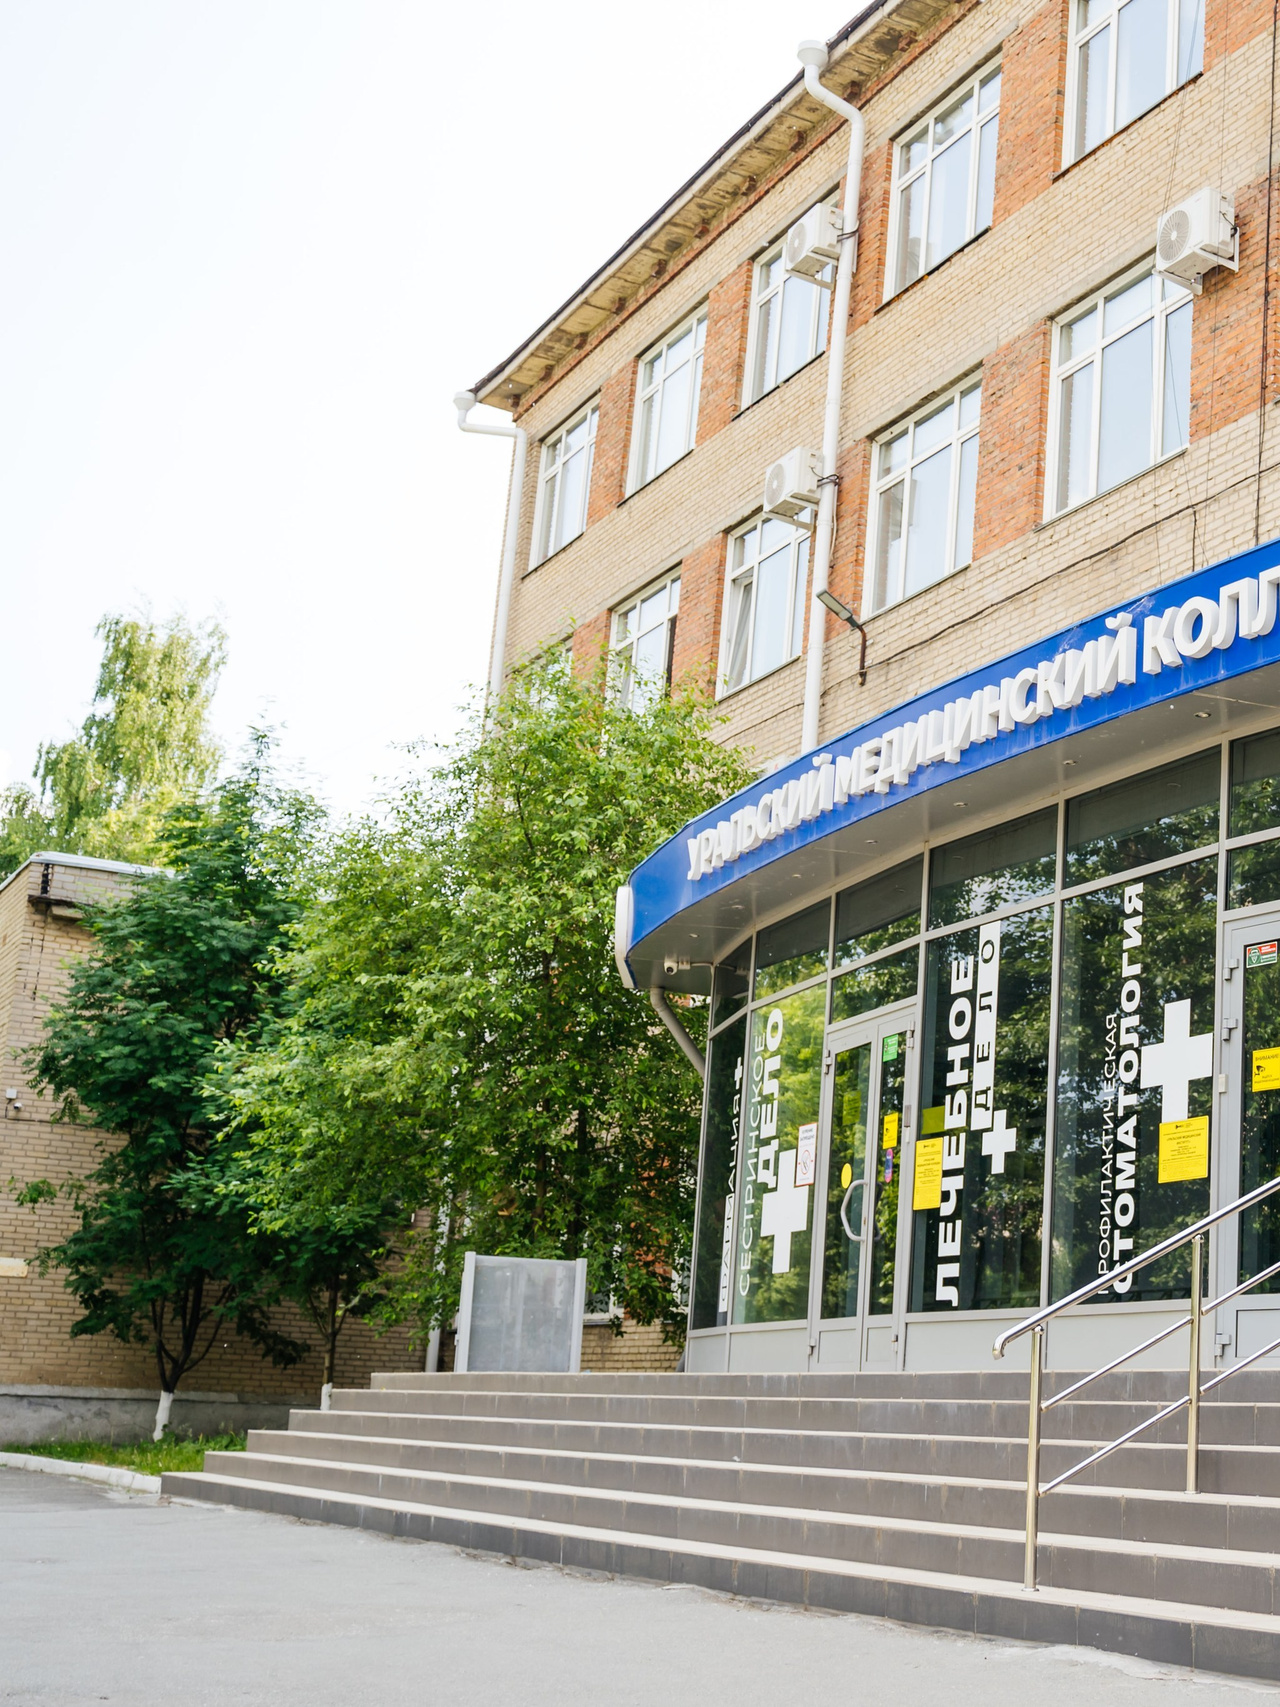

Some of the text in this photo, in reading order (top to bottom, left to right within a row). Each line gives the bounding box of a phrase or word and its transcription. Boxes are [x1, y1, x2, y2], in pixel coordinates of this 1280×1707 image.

[687, 755, 834, 881] УРАЛЬСКИЙ
[834, 616, 1136, 804] МЕДИЦИНСКИЙ
[757, 1008, 784, 1189] ДЕЛО
[935, 954, 975, 1307] ЛЕЧЕБНОЕ
[974, 938, 995, 1116] ДЕЛО
[1112, 882, 1144, 1295] СТОМАТОЛОГИЯ
[739, 1031, 765, 1296] СЕСТРИНСКОЕ
